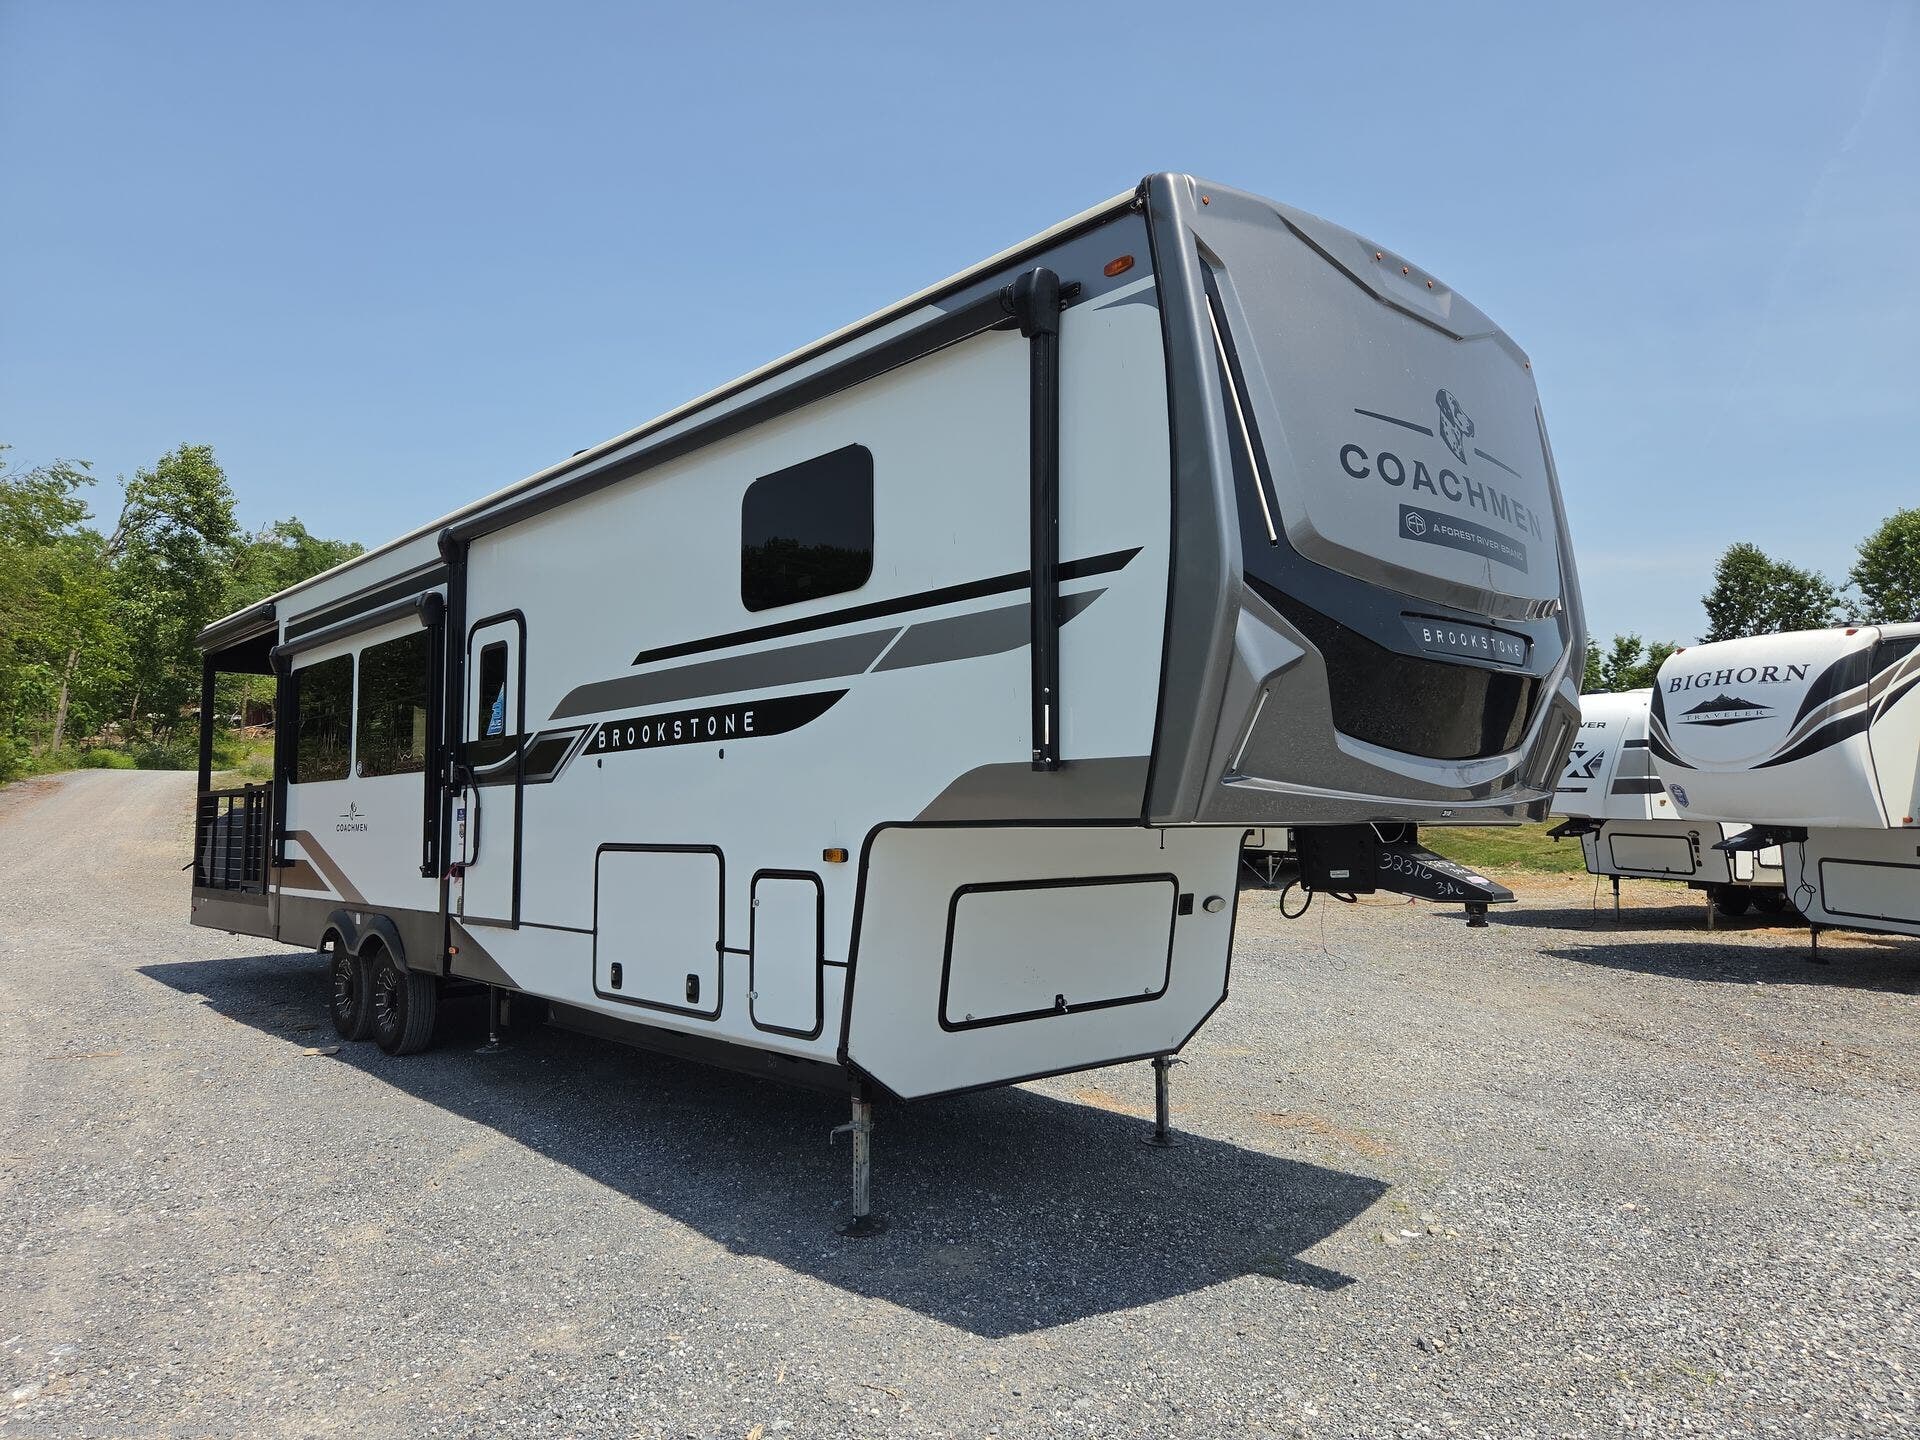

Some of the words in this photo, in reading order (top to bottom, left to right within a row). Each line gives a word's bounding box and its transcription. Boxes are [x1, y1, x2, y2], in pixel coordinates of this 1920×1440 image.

[1339, 443, 1543, 542] COACHMEN
[1433, 523, 1441, 534] A
[1441, 526, 1476, 542] FOREST
[1477, 536, 1500, 550] RIVER
[1501, 545, 1524, 561] BRAND
[1422, 627, 1521, 657] BROOKSTONE
[1667, 663, 1811, 694] BIGHORN
[598, 711, 754, 749] BROOKSTONE
[1580, 721, 1607, 729] VER
[1686, 709, 1765, 721] TRAVELER
[335, 823, 368, 832] COACHMEN
[1379, 852, 1433, 880] 32316
